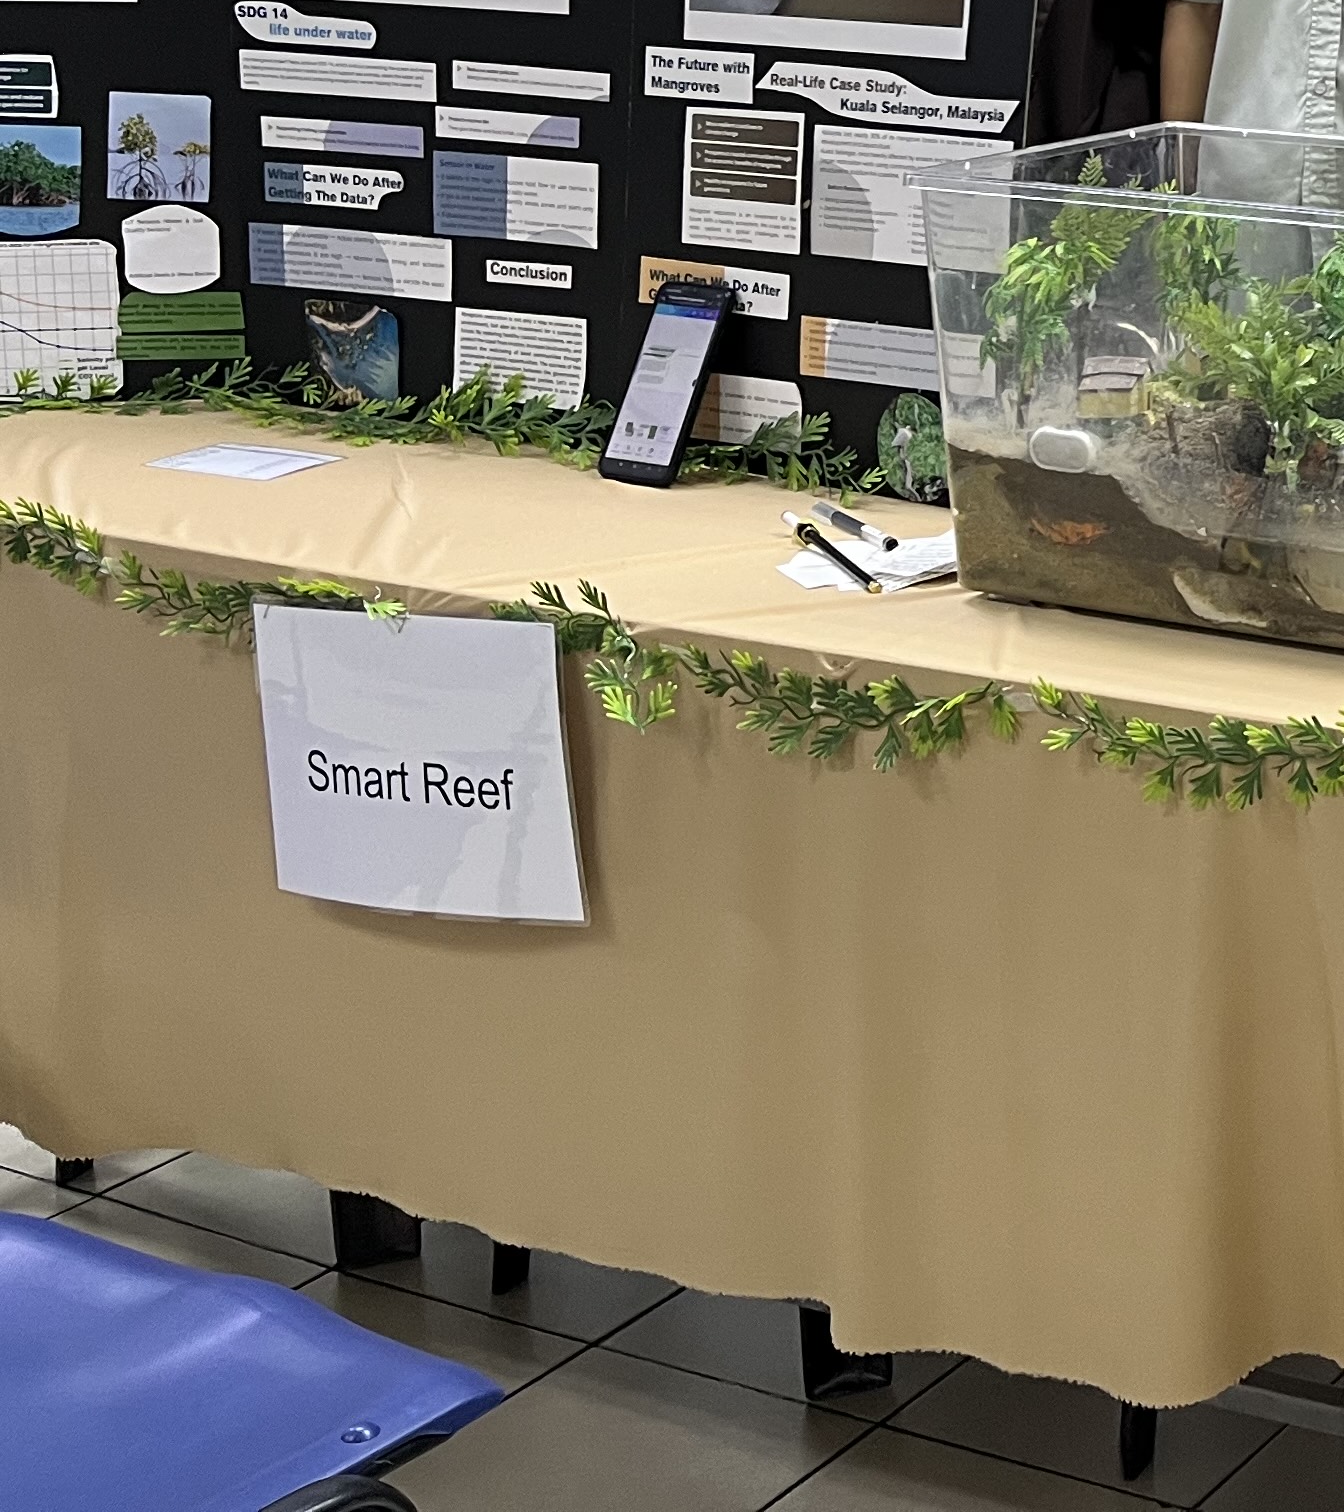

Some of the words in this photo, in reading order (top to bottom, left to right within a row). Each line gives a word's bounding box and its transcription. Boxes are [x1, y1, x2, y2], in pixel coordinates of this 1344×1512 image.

[237, 5, 268, 19] SDG
[272, 7, 288, 19] 14
[269, 23, 290, 36] life
[294, 25, 332, 39] under
[335, 29, 373, 41] water
[651, 55, 674, 69] The
[678, 57, 719, 72] Future
[723, 61, 750, 74] with
[651, 75, 721, 94] Mangroves
[770, 73, 825, 90] Real-Life
[829, 76, 861, 92] Case
[865, 79, 907, 97] Study:
[840, 98, 877, 113] Kuala
[881, 100, 943, 120] Selangor,
[946, 104, 1005, 124] Malaysia
[267, 167, 299, 182] What
[302, 171, 326, 183] Can
[329, 173, 349, 186] We
[352, 175, 369, 187] Do
[372, 176, 402, 190] After
[268, 186, 312, 203] Getting
[315, 190, 337, 203] The
[341, 191, 375, 206] Data?
[490, 261, 568, 282] Conclusion
[732, 278, 749, 293] Do
[752, 282, 781, 297] After
[307, 749, 411, 803] Smart
[422, 761, 515, 811] Reef
